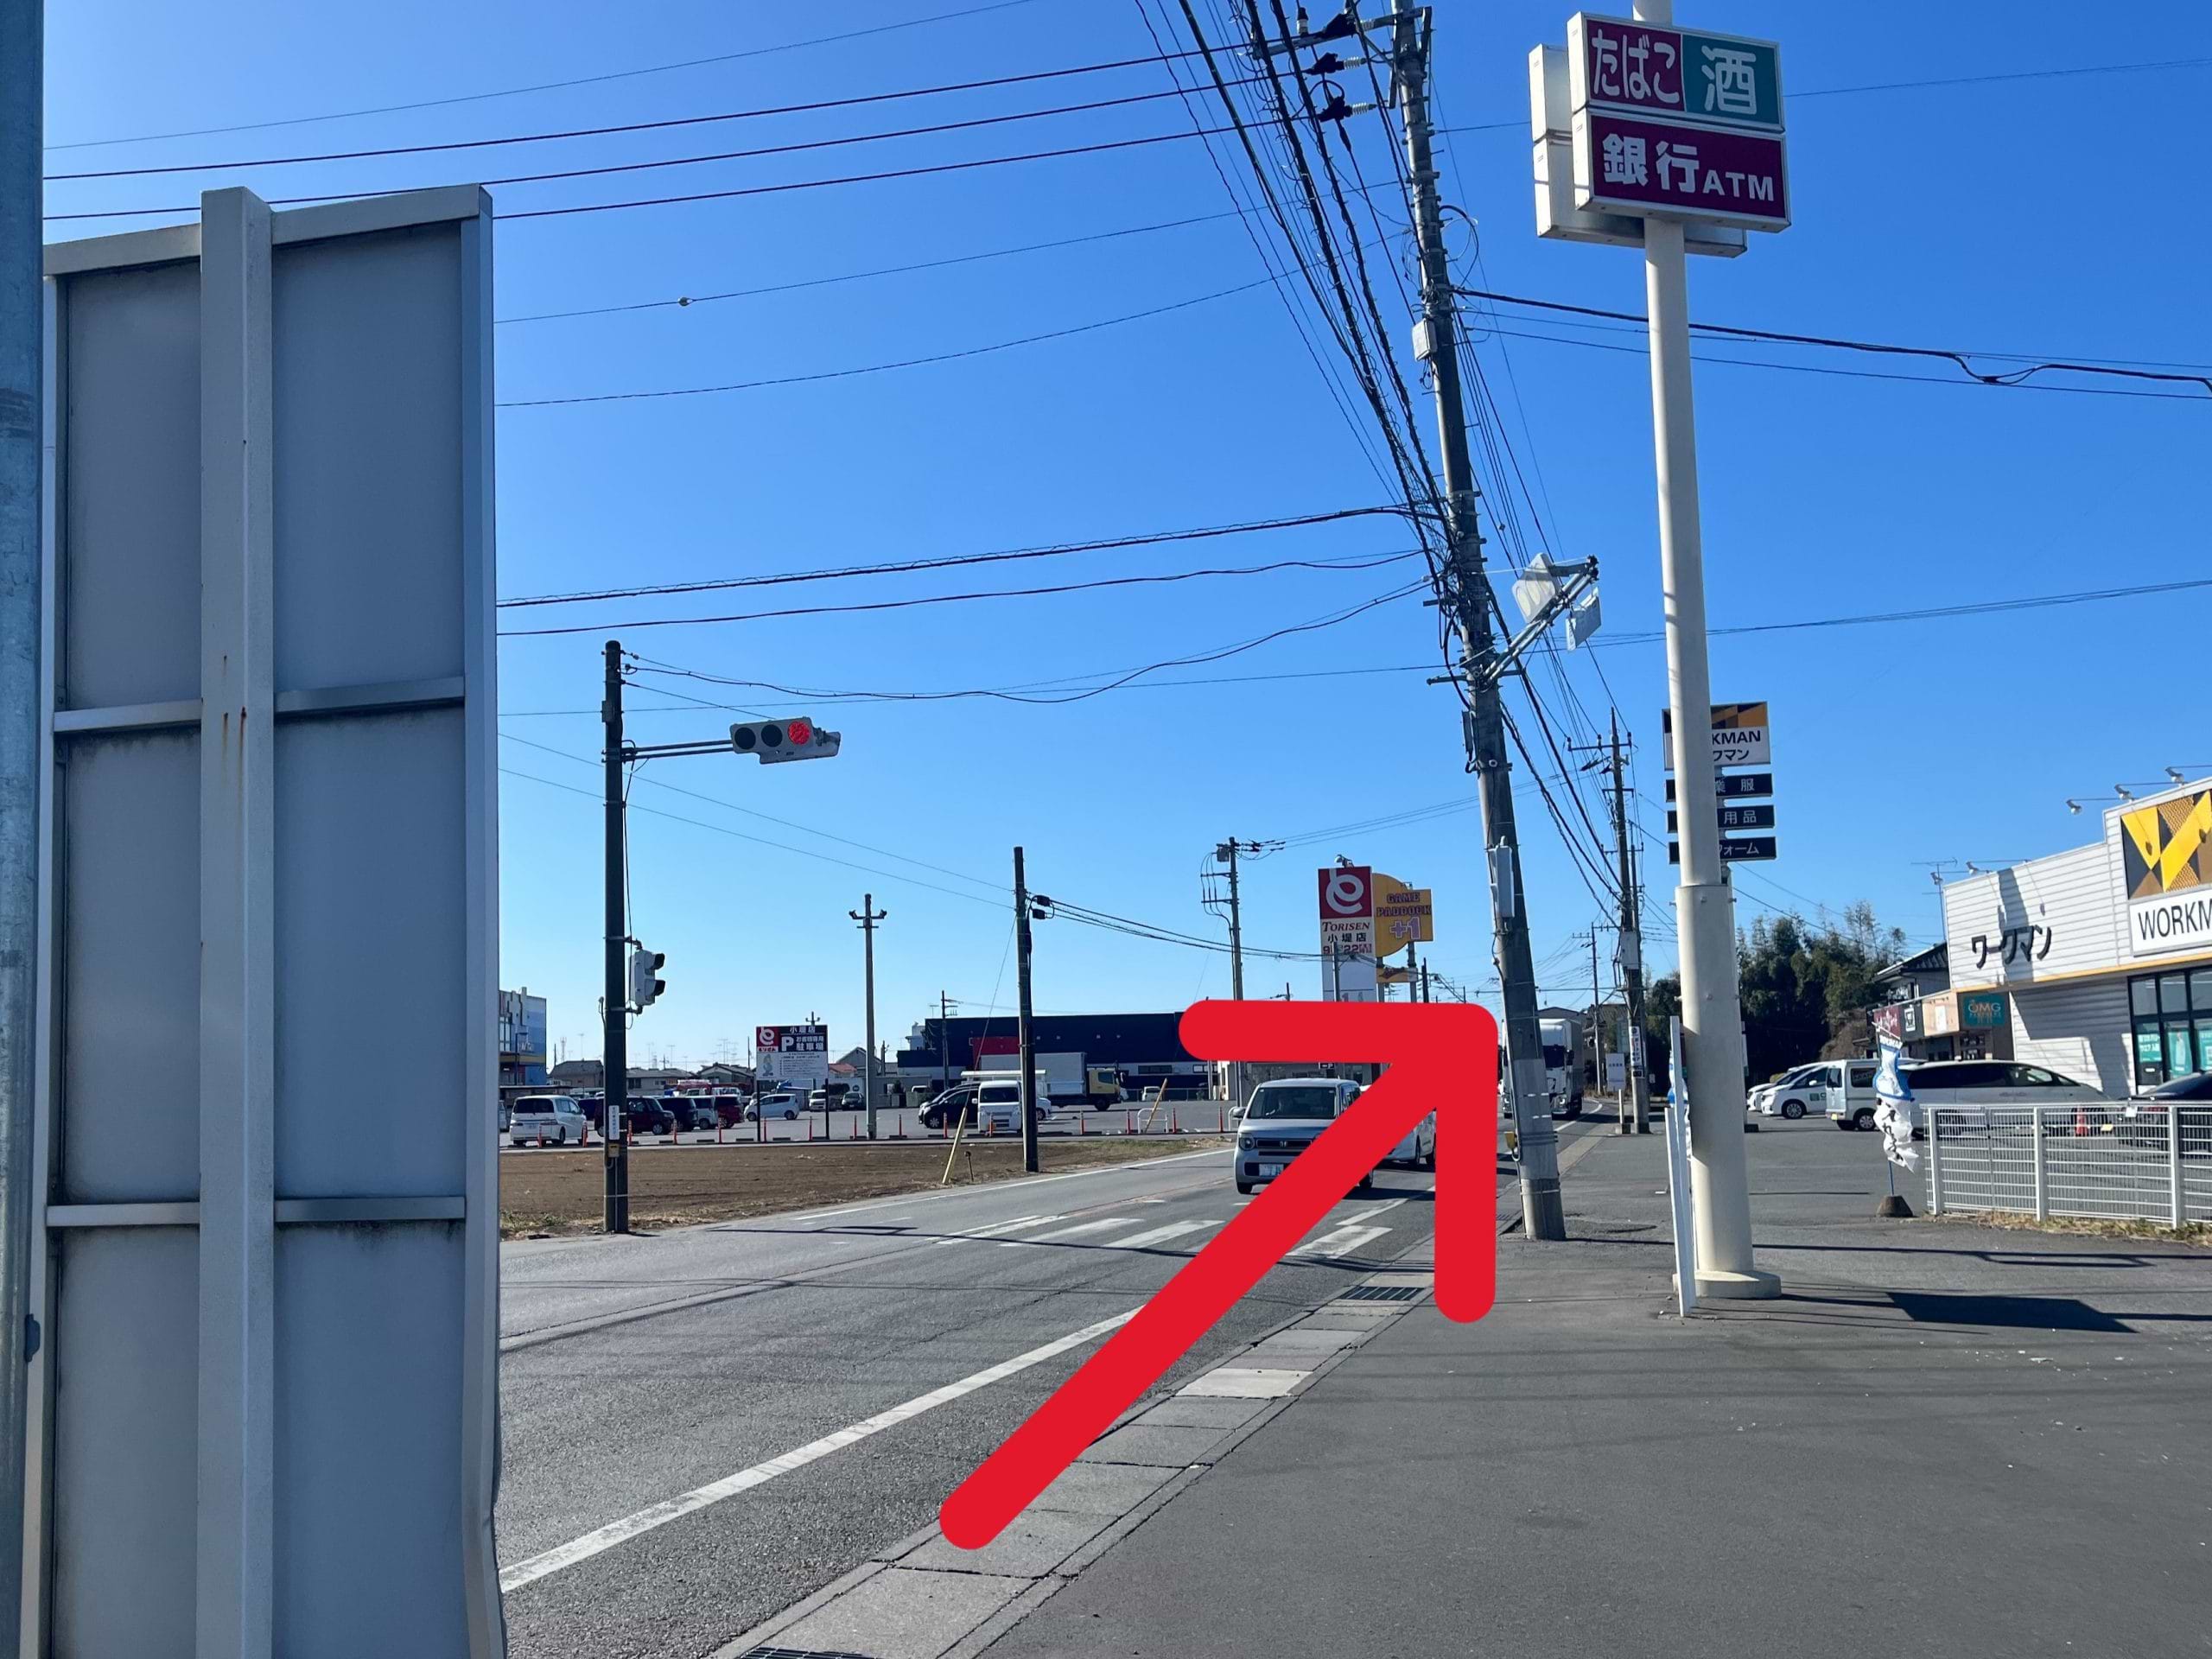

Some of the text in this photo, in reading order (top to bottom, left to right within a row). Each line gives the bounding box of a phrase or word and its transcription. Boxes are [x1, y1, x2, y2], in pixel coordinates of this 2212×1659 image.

[1591, 28, 1681, 104] たばこ
[1700, 45, 1758, 115] 酒
[1602, 133, 1775, 202] 銀行ATM
[1712, 729, 1761, 746] KMAN
[1714, 778, 1755, 793] 業服
[1724, 810, 1757, 824] 用品
[1387, 892, 1421, 904] GAME
[1376, 905, 1432, 918] PADDOCK
[1322, 921, 1370, 932] TORISEN
[1971, 924, 2052, 969] ワークマン
[781, 1036, 794, 1052] P
